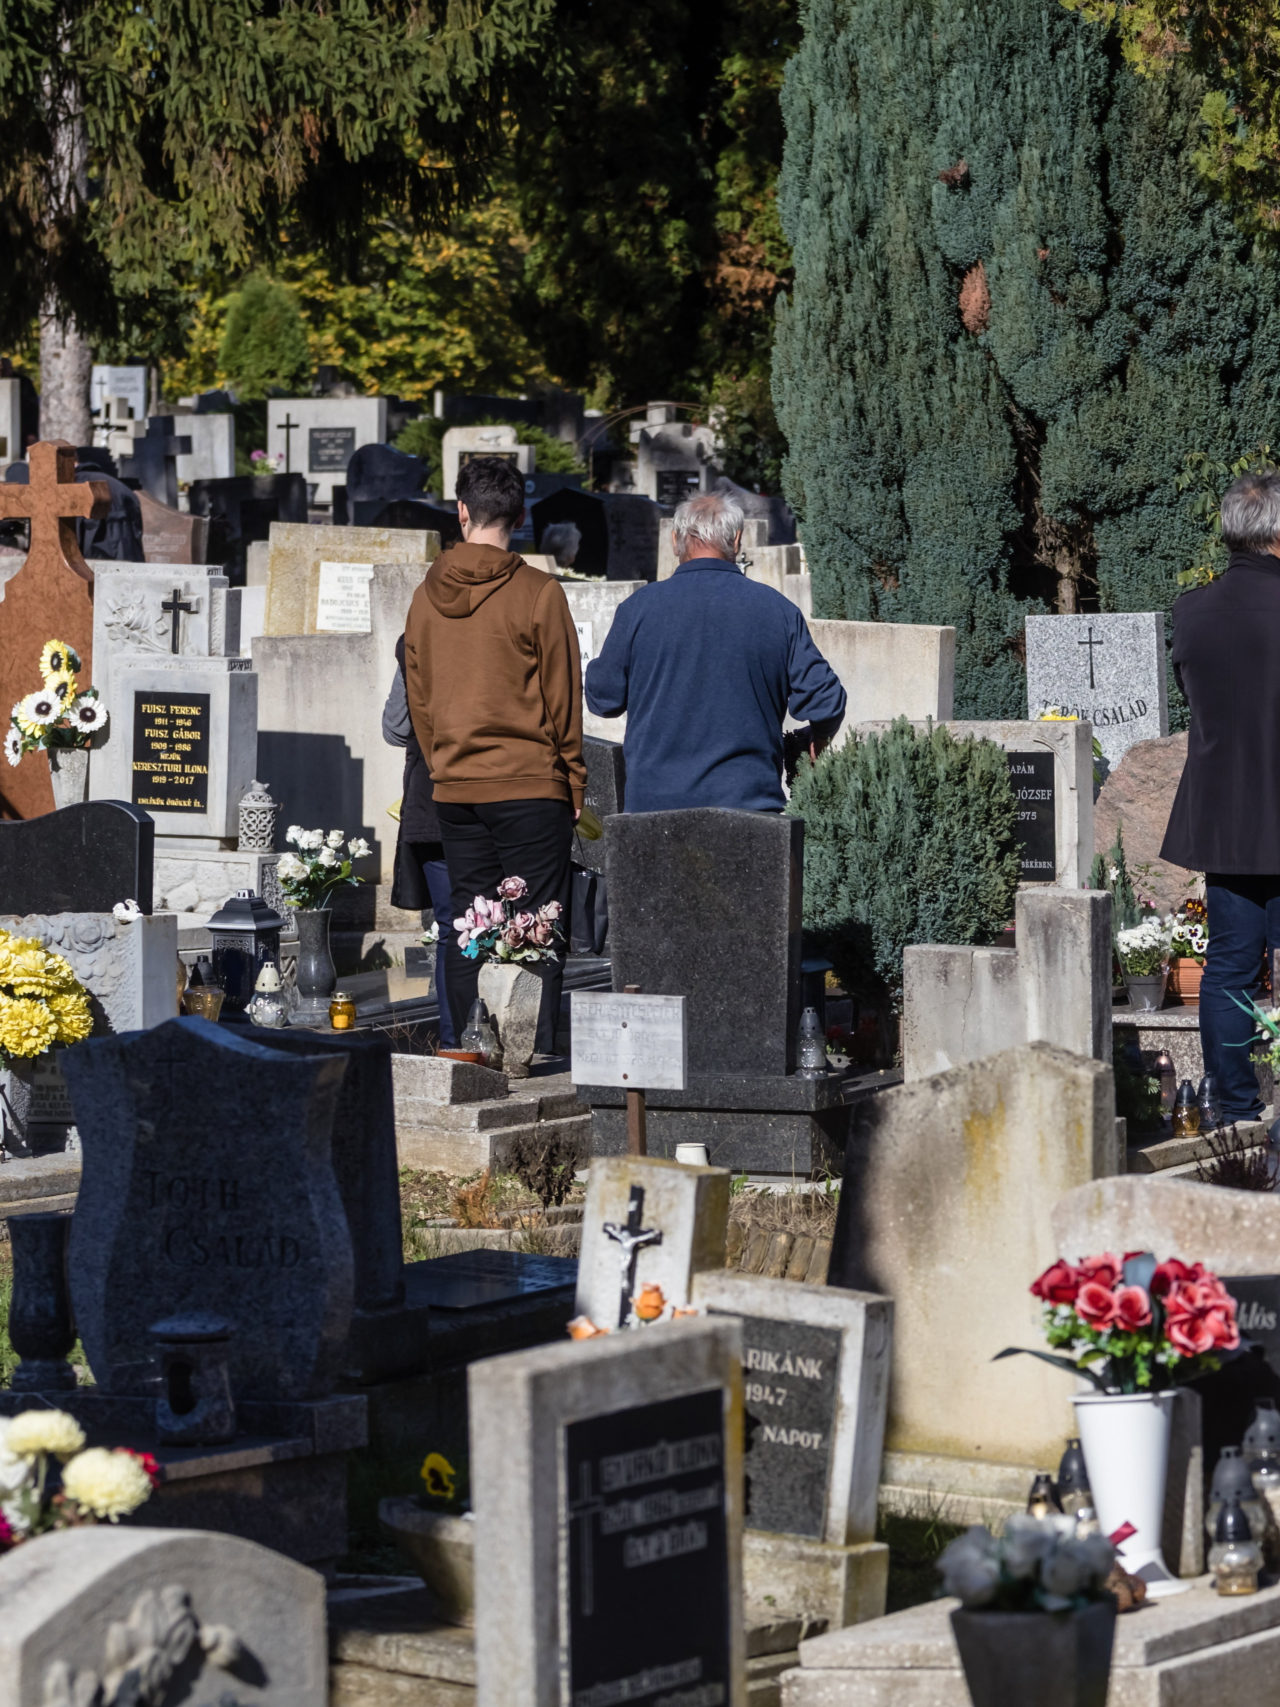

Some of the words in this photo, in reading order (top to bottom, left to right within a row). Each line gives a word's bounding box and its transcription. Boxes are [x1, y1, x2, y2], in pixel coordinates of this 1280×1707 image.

[141, 704, 167, 714] FUISZ
[169, 705, 202, 716] FERENC
[1092, 696, 1148, 727] CSALÁD
[144, 728, 169, 739] FUISZ
[172, 728, 201, 740] GÁBOR
[183, 763, 208, 774] ILONA
[174, 776, 195, 785] 2017
[1016, 786, 1053, 801] JÓZSEF
[745, 1382, 788, 1407] 1947
[762, 1425, 824, 1450] NAPOT
